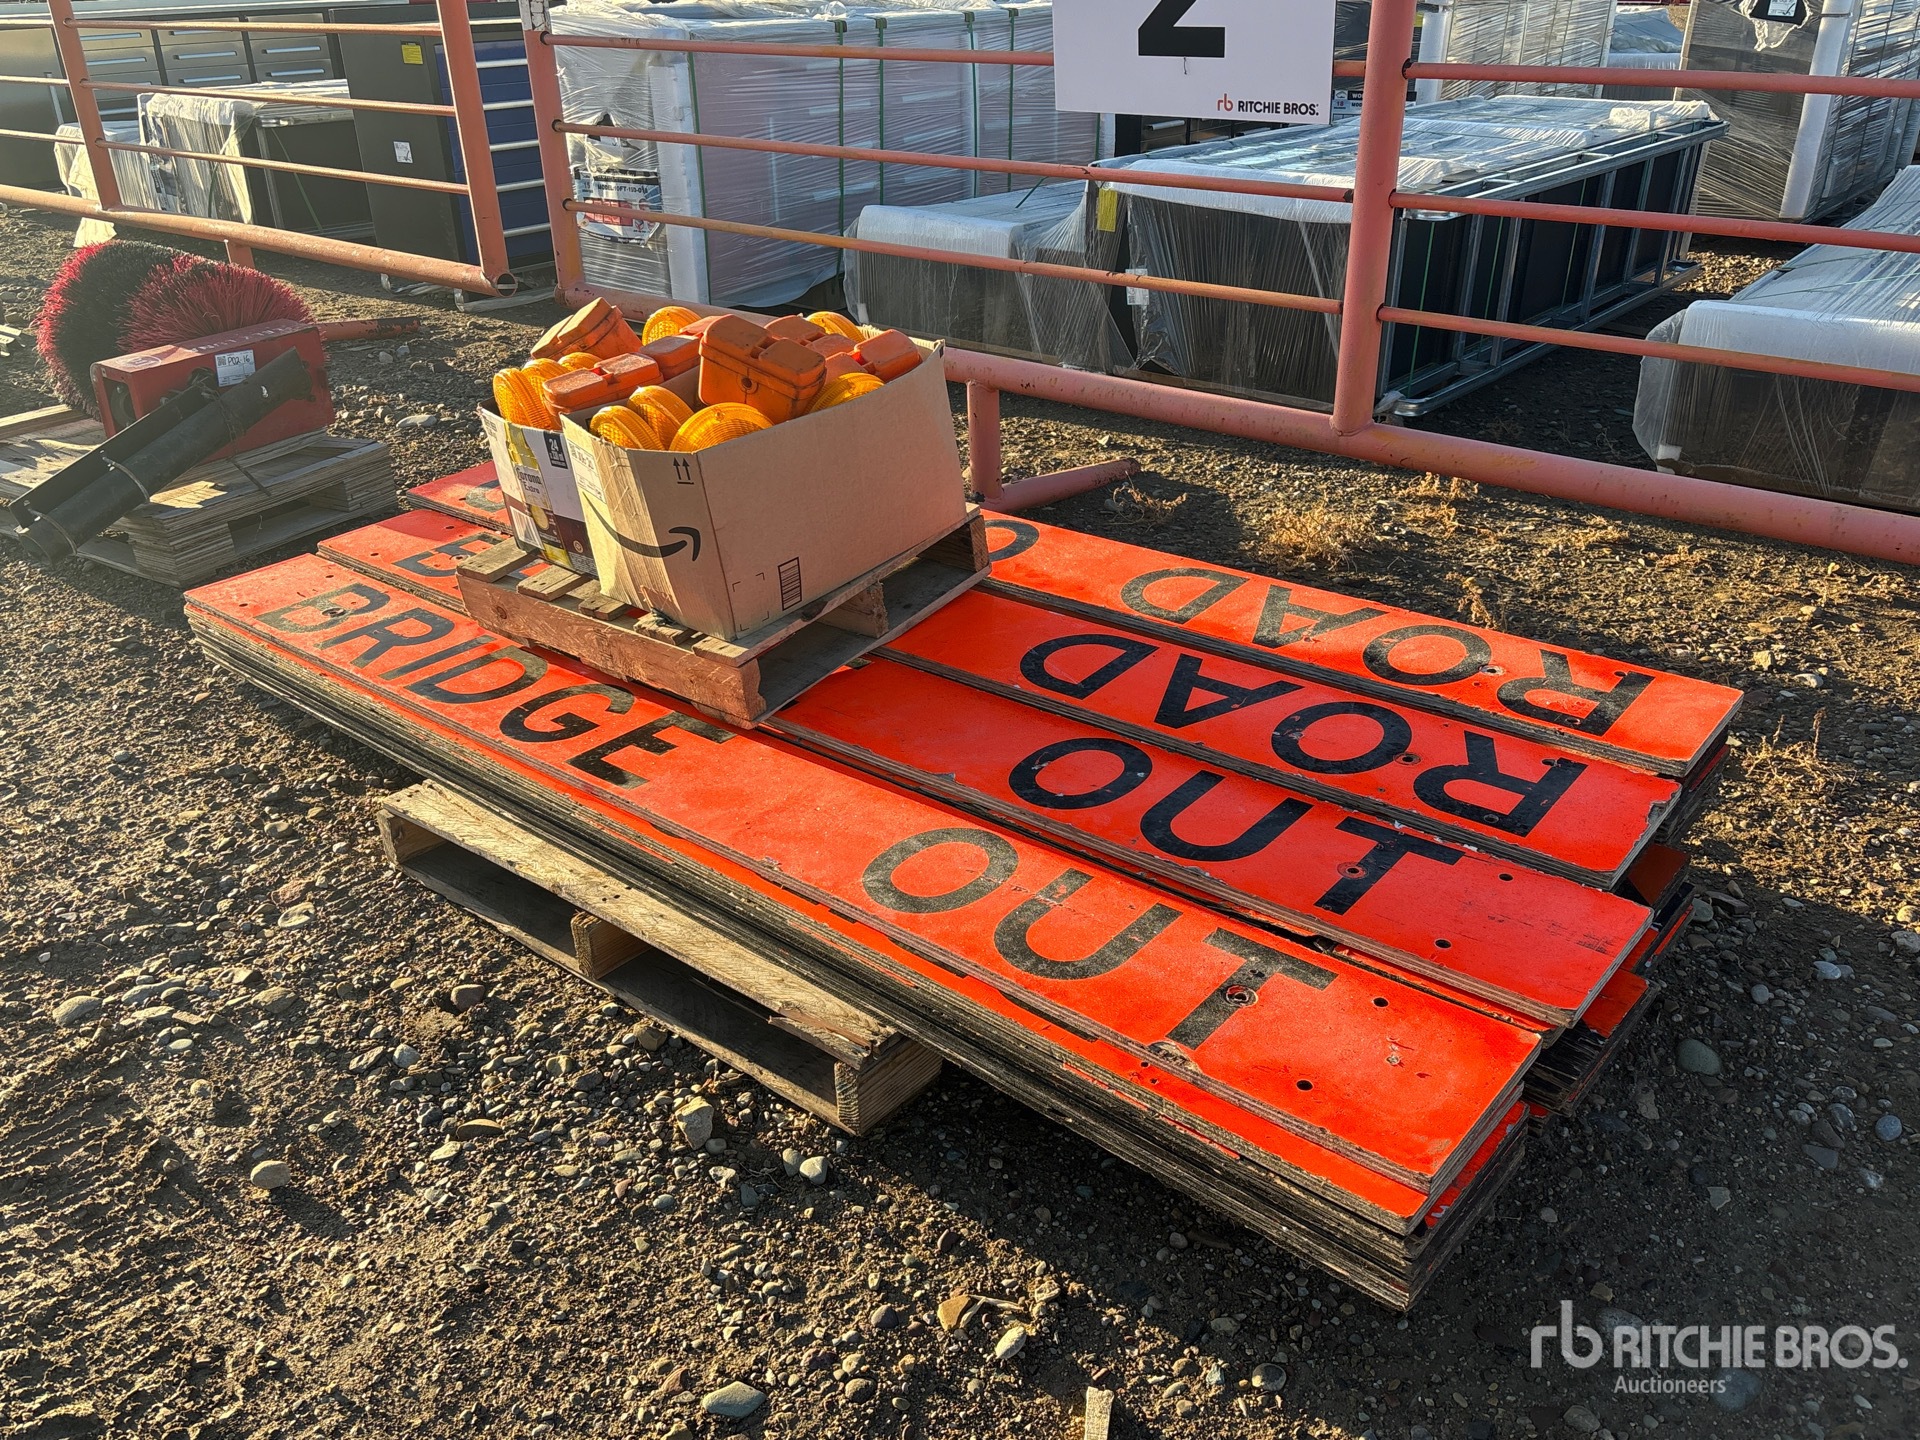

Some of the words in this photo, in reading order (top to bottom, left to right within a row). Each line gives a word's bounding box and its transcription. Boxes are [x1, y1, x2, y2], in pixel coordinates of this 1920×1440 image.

[1217, 93, 1233, 111] rb
[1238, 100, 1281, 114] RITCHIE
[516, 467, 542, 485] Corona
[523, 480, 540, 494] Extra
[548, 438, 559, 452] 24
[255, 583, 738, 790] BRIDGE
[1019, 634, 1587, 837] ROAD
[1120, 567, 1655, 736] ROAD
[1008, 737, 1466, 916] OUT
[861, 827, 1339, 1050] OUT
